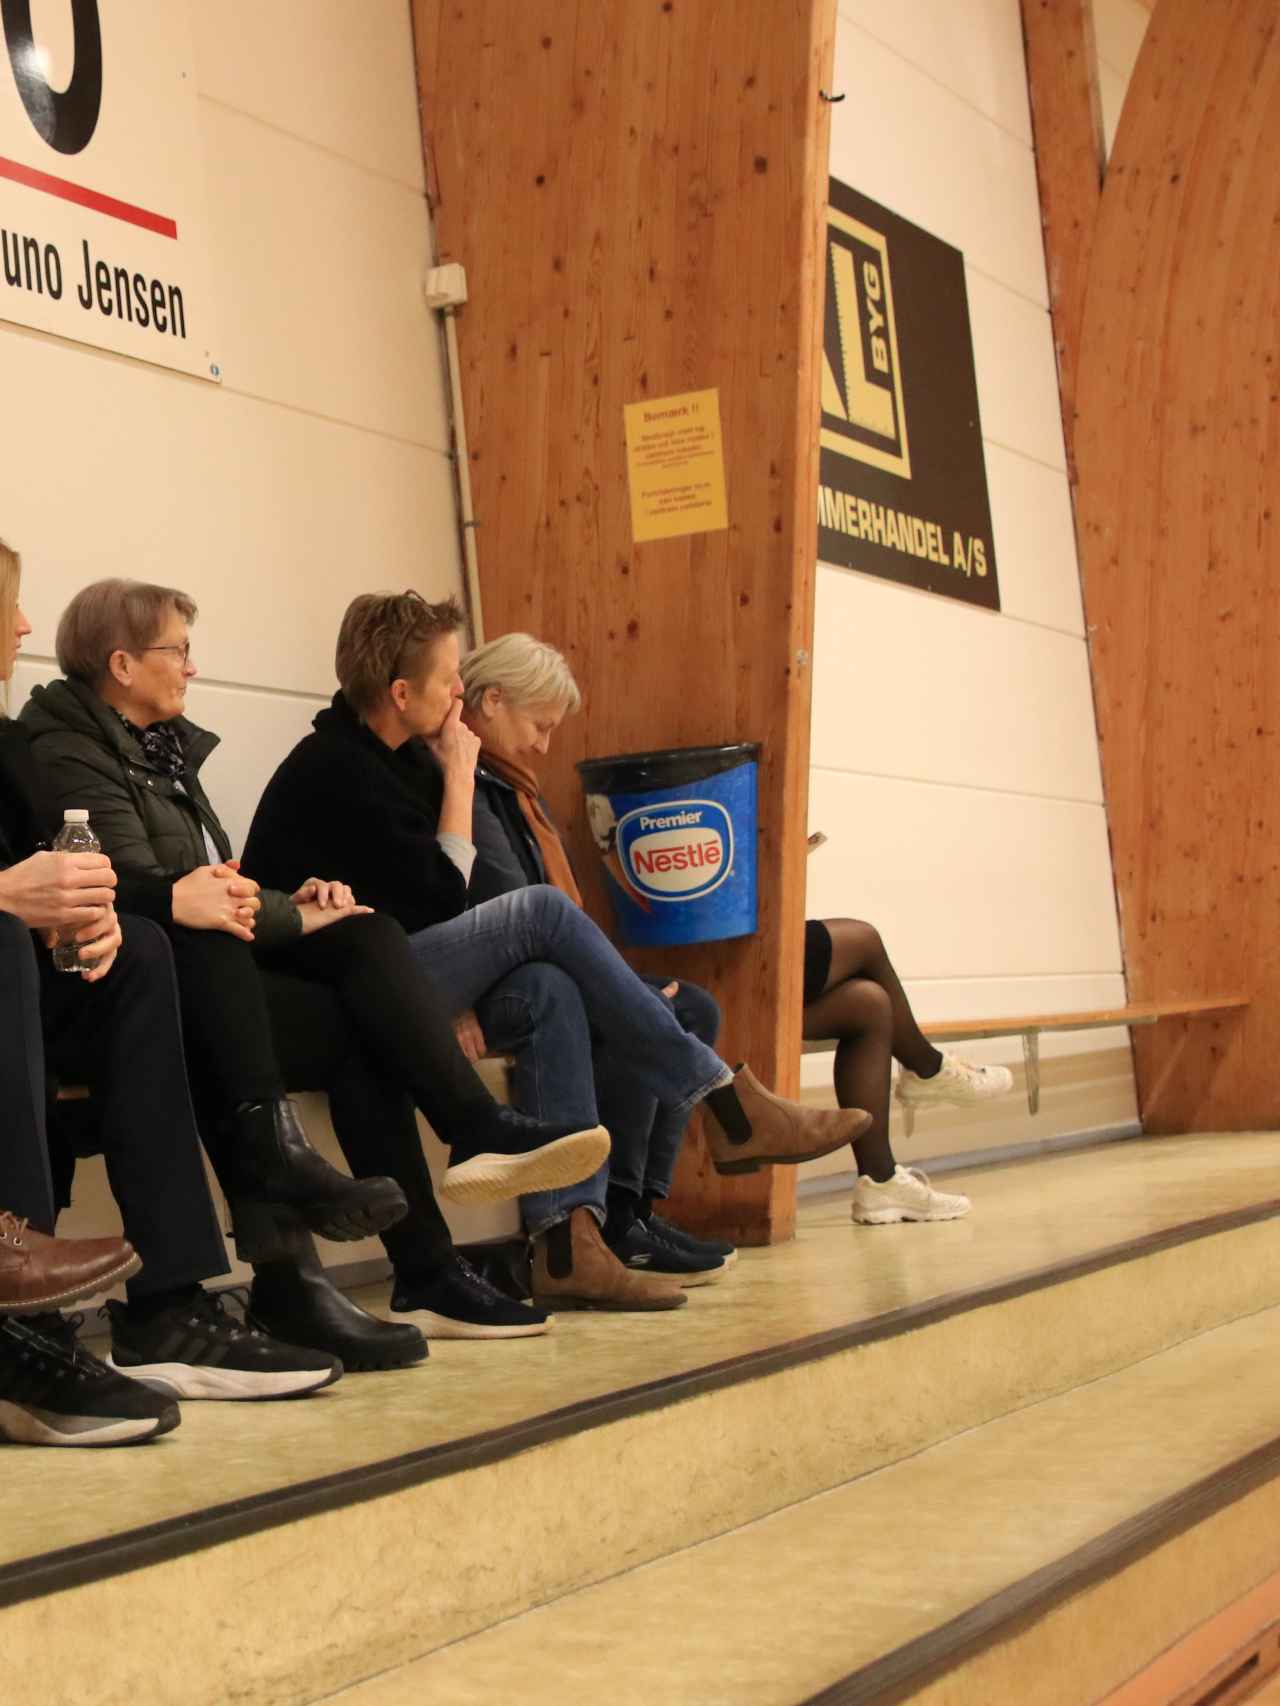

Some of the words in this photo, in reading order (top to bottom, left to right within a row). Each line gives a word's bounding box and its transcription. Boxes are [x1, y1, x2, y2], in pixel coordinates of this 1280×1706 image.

[76, 239, 187, 340] Jensen
[862, 260, 890, 375] BYG
[953, 531, 988, 578] A/S
[639, 810, 704, 831] Premier
